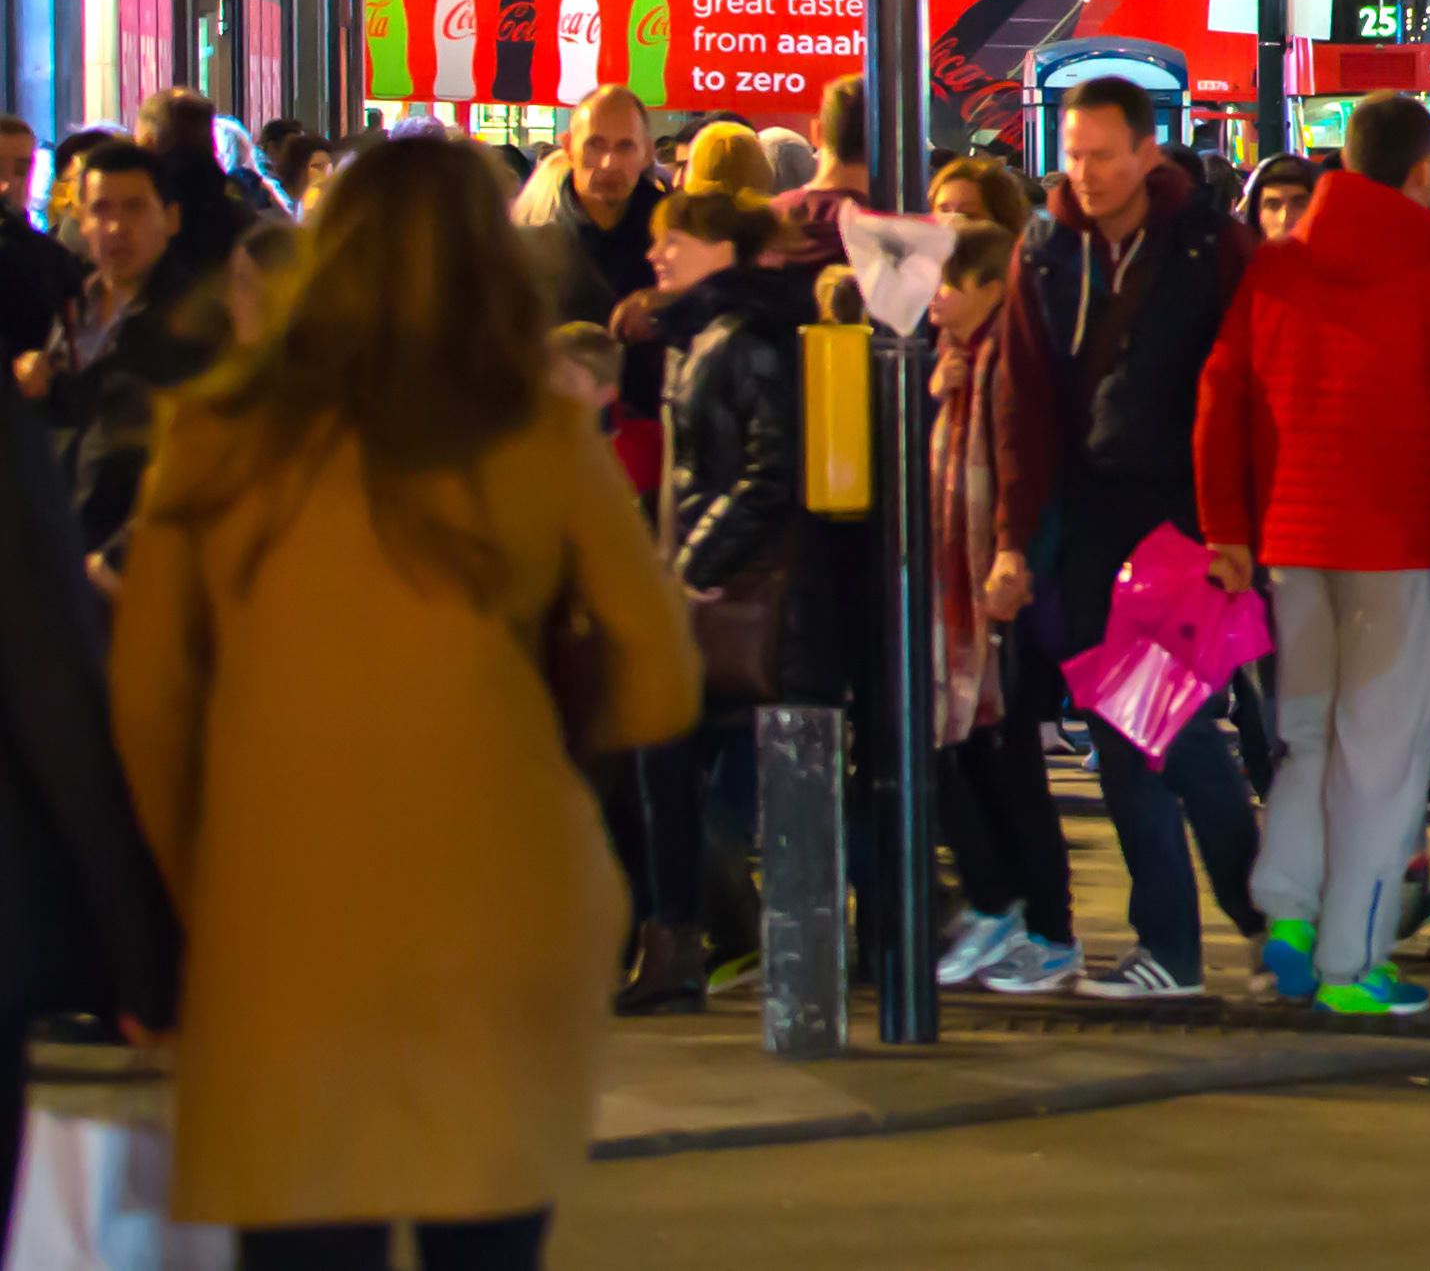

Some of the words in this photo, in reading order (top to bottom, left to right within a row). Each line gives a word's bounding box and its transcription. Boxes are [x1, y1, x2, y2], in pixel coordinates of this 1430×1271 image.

[1359, 6, 1398, 38] 25
[693, 26, 766, 52] from
[777, 31, 868, 56] aaaah
[692, 67, 725, 91] to
[736, 72, 805, 93] zero
